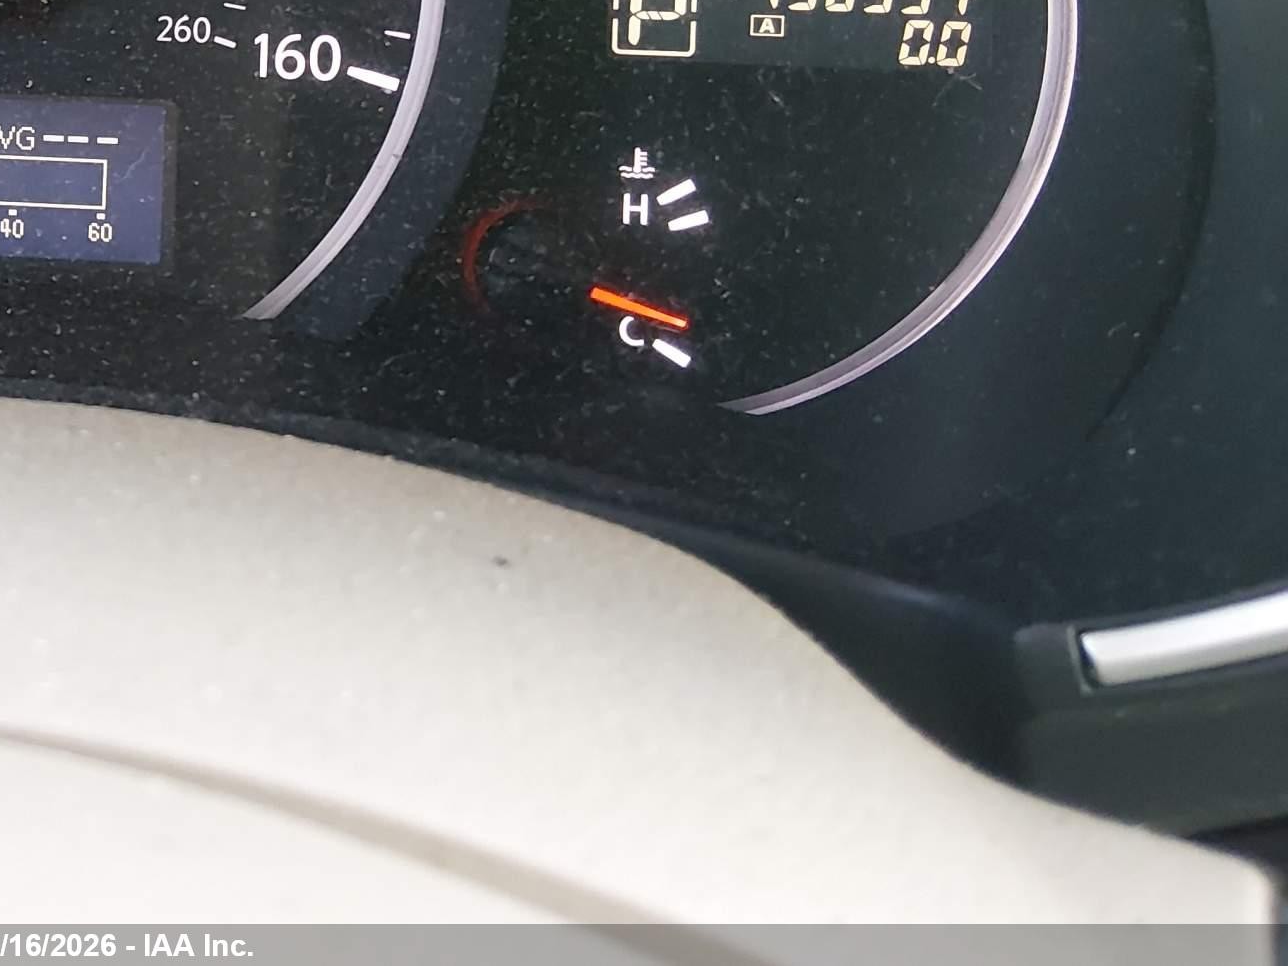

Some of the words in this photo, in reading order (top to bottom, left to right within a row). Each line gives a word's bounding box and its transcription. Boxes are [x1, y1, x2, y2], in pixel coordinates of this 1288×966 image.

[156, 14, 211, 44] 260
[898, 19, 973, 68] 0.0
[253, 32, 342, 82] 160
[622, 192, 649, 226] H
[0, 218, 25, 239] 40
[87, 222, 113, 243] 60
[618, 315, 645, 347] C
